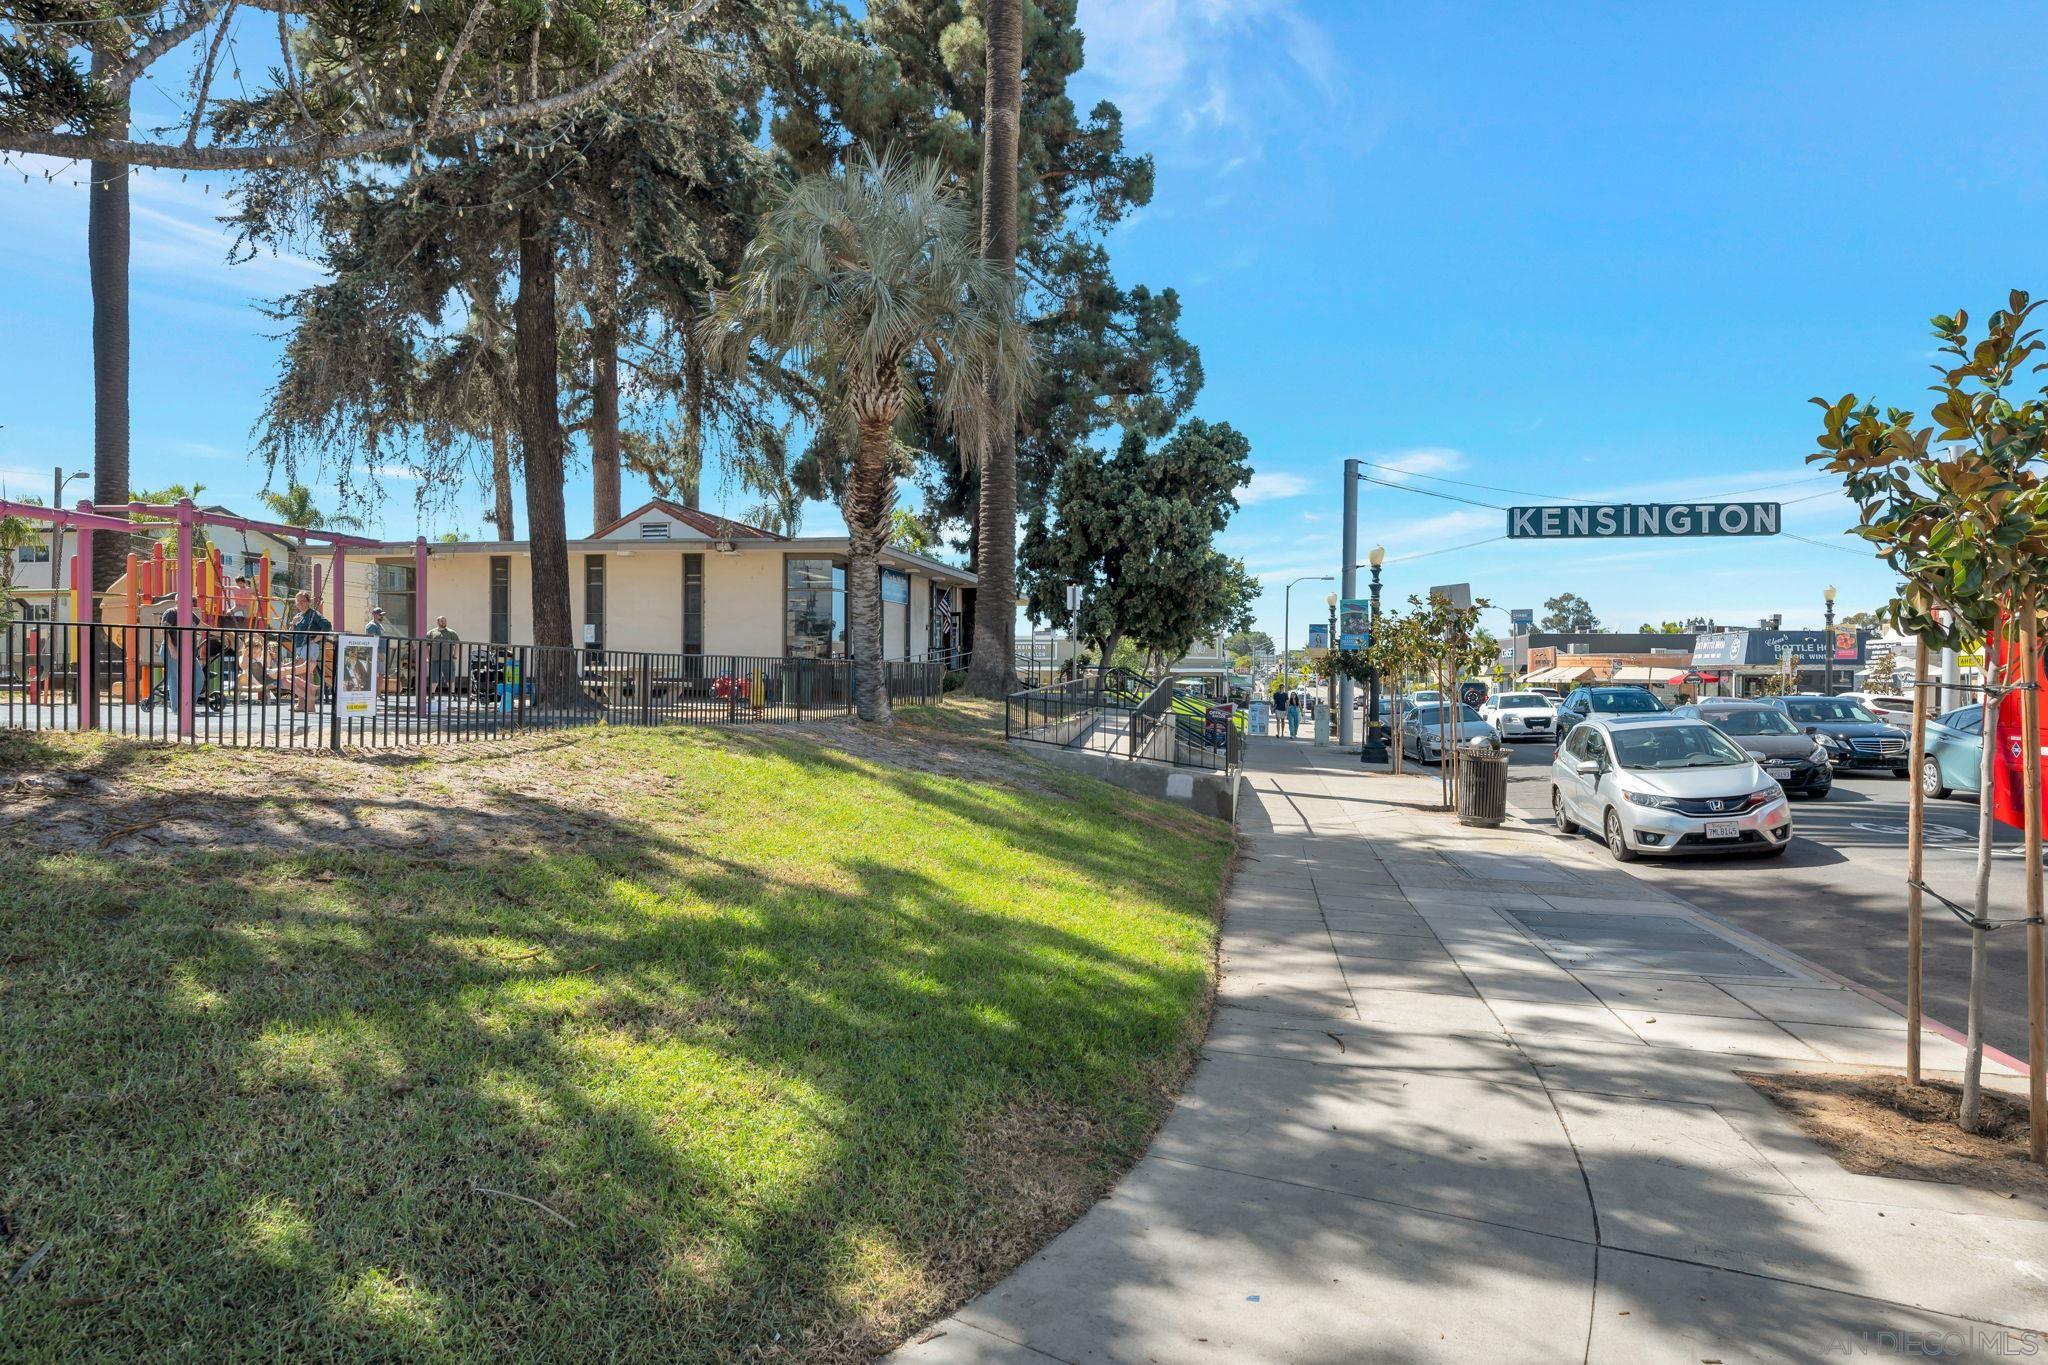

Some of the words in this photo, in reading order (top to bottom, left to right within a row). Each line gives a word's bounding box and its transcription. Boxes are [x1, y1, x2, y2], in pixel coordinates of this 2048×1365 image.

[1513, 504, 1776, 536] KENSINGTON
[1774, 643, 1814, 652] BOTTLE
[1708, 827, 1737, 837] 7MLB145
